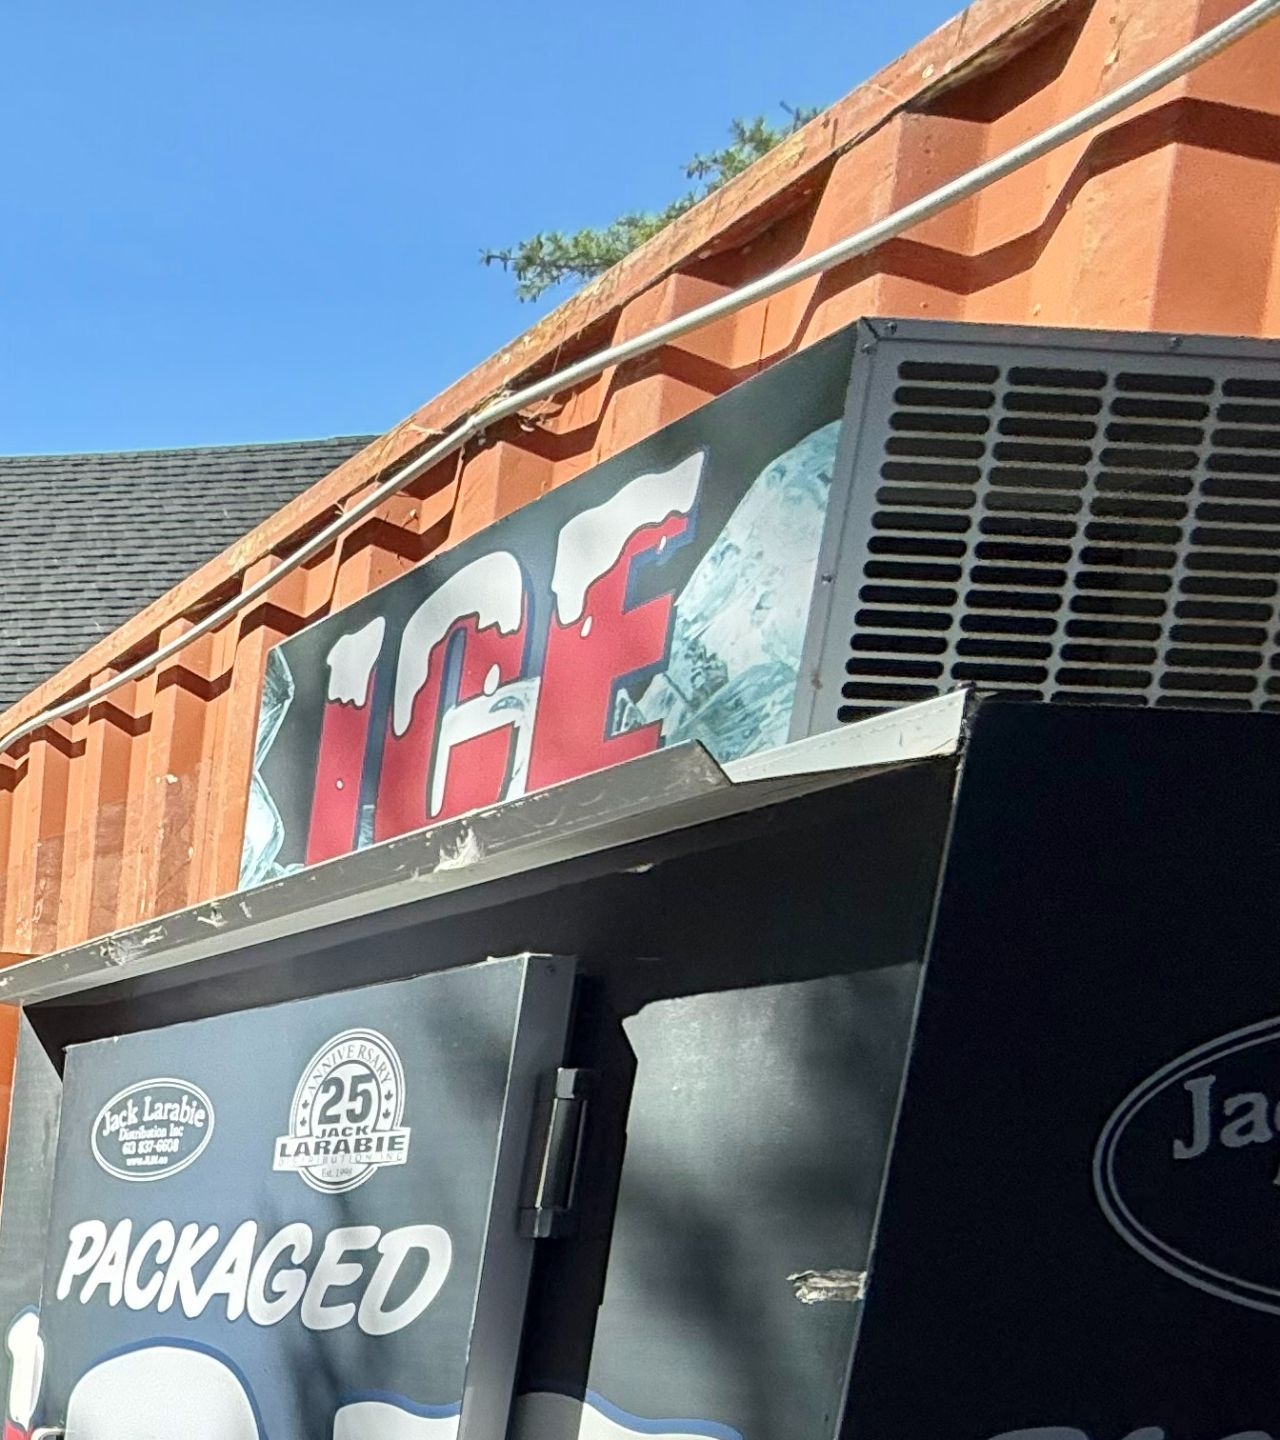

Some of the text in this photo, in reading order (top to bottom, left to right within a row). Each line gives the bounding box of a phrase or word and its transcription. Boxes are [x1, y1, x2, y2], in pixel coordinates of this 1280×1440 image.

[304, 446, 710, 868] ICE
[102, 1094, 206, 1137] Jack Larabie
[317, 1072, 375, 1126] 25
[1173, 1074, 1280, 1160] Ja
[279, 1134, 406, 1158] LARABIE
[315, 1124, 370, 1139] JACK
[56, 1219, 453, 1336] PACKAGED
